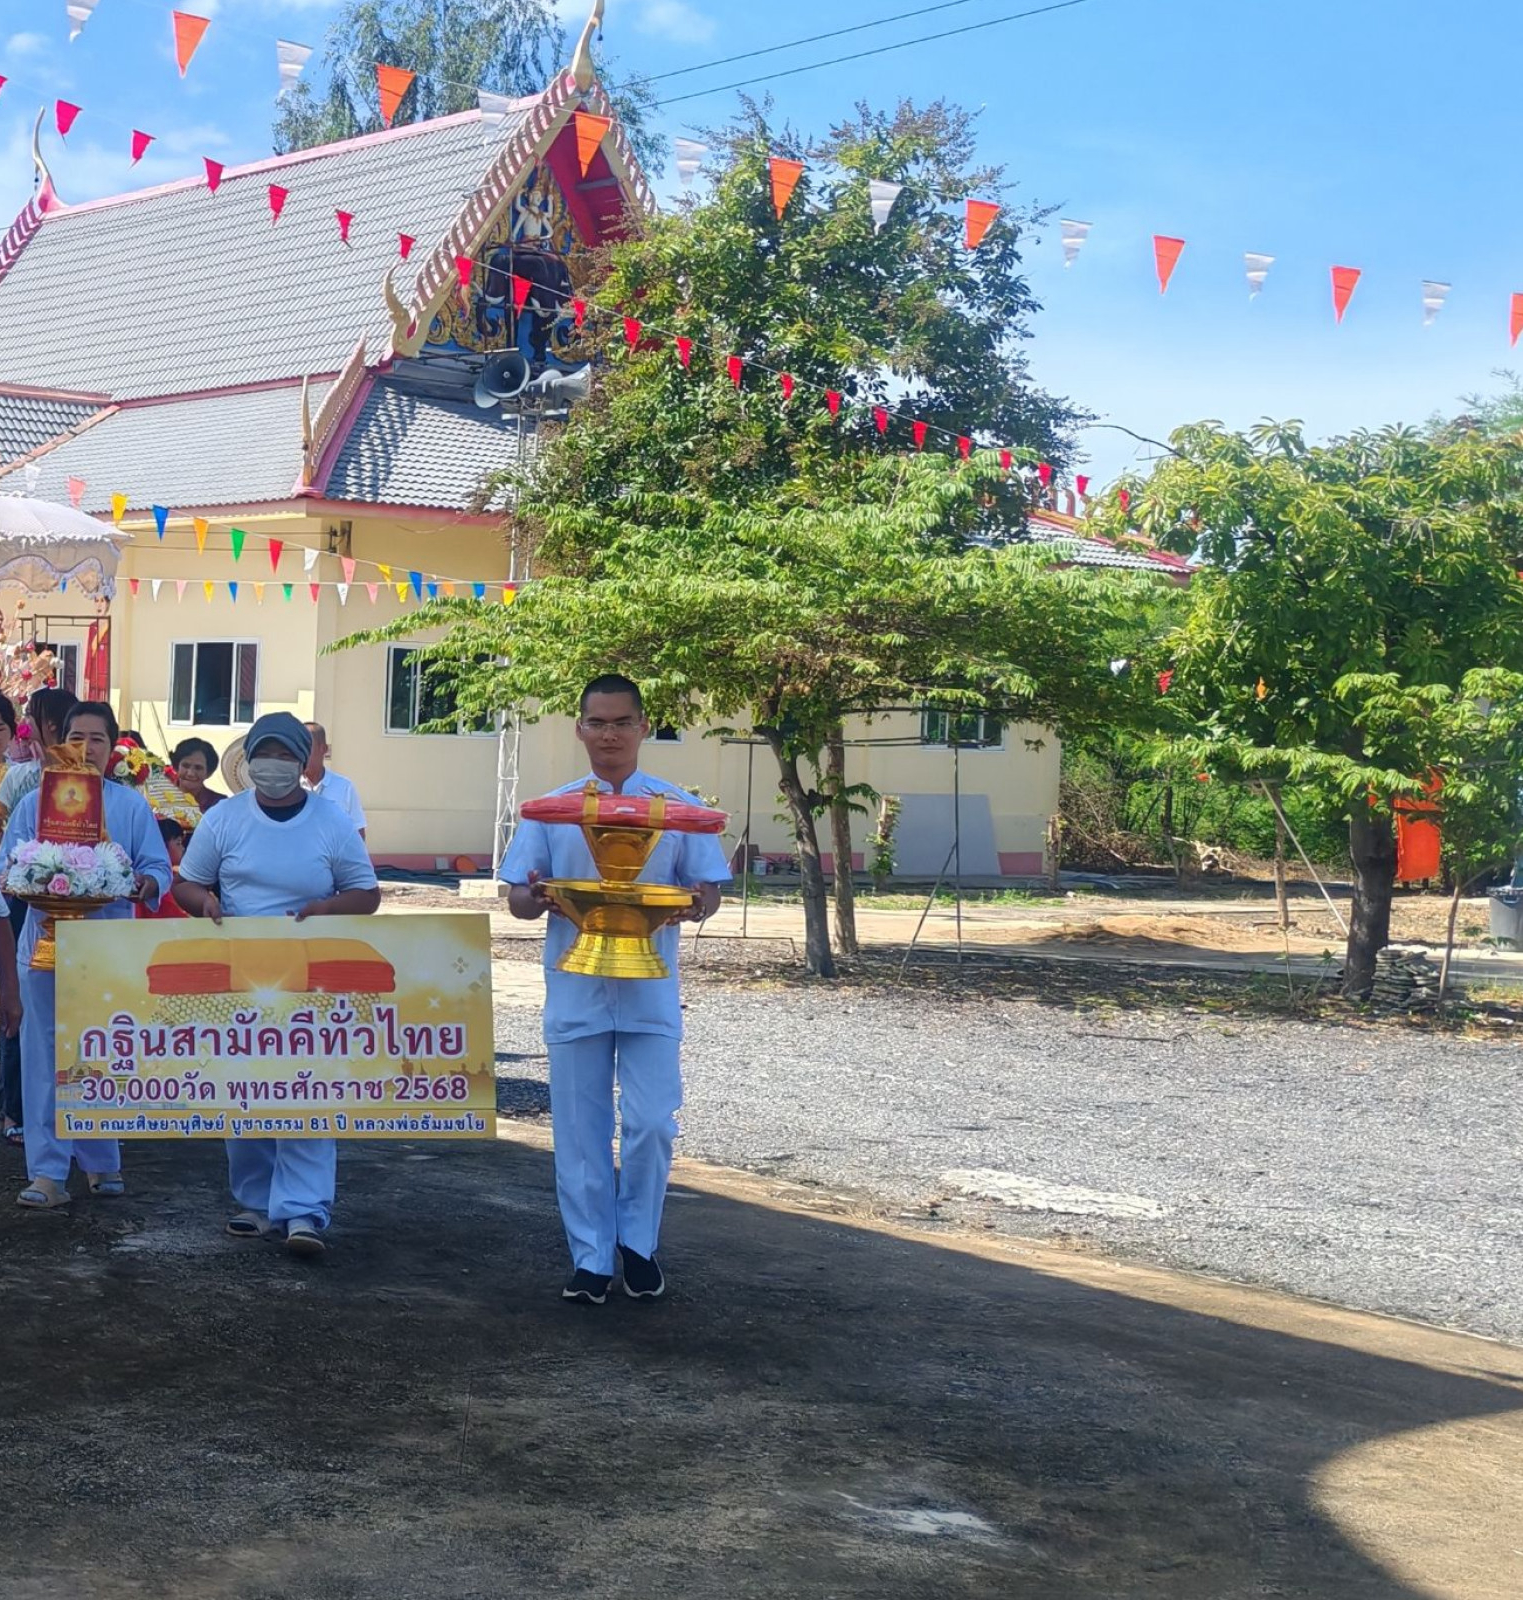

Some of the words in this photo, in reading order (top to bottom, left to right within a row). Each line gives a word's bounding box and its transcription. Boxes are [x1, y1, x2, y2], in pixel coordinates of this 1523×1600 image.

[83, 999, 463, 1071] กฐินสามัคคีทั่วไทย
[82, 1071, 216, 1106] 30,000วัด
[227, 1070, 383, 1110] พุทธศักราช
[394, 1076, 468, 1100] 2568
[65, 1114, 94, 1131] โดย
[101, 1112, 225, 1135] คณะศิษยานุศิษย์
[231, 1118, 304, 1136] บูชาธรรม
[310, 1117, 329, 1131] 81
[335, 1113, 347, 1131] ปี
[353, 1112, 485, 1131] หลวงพ่อธัมมชโย
